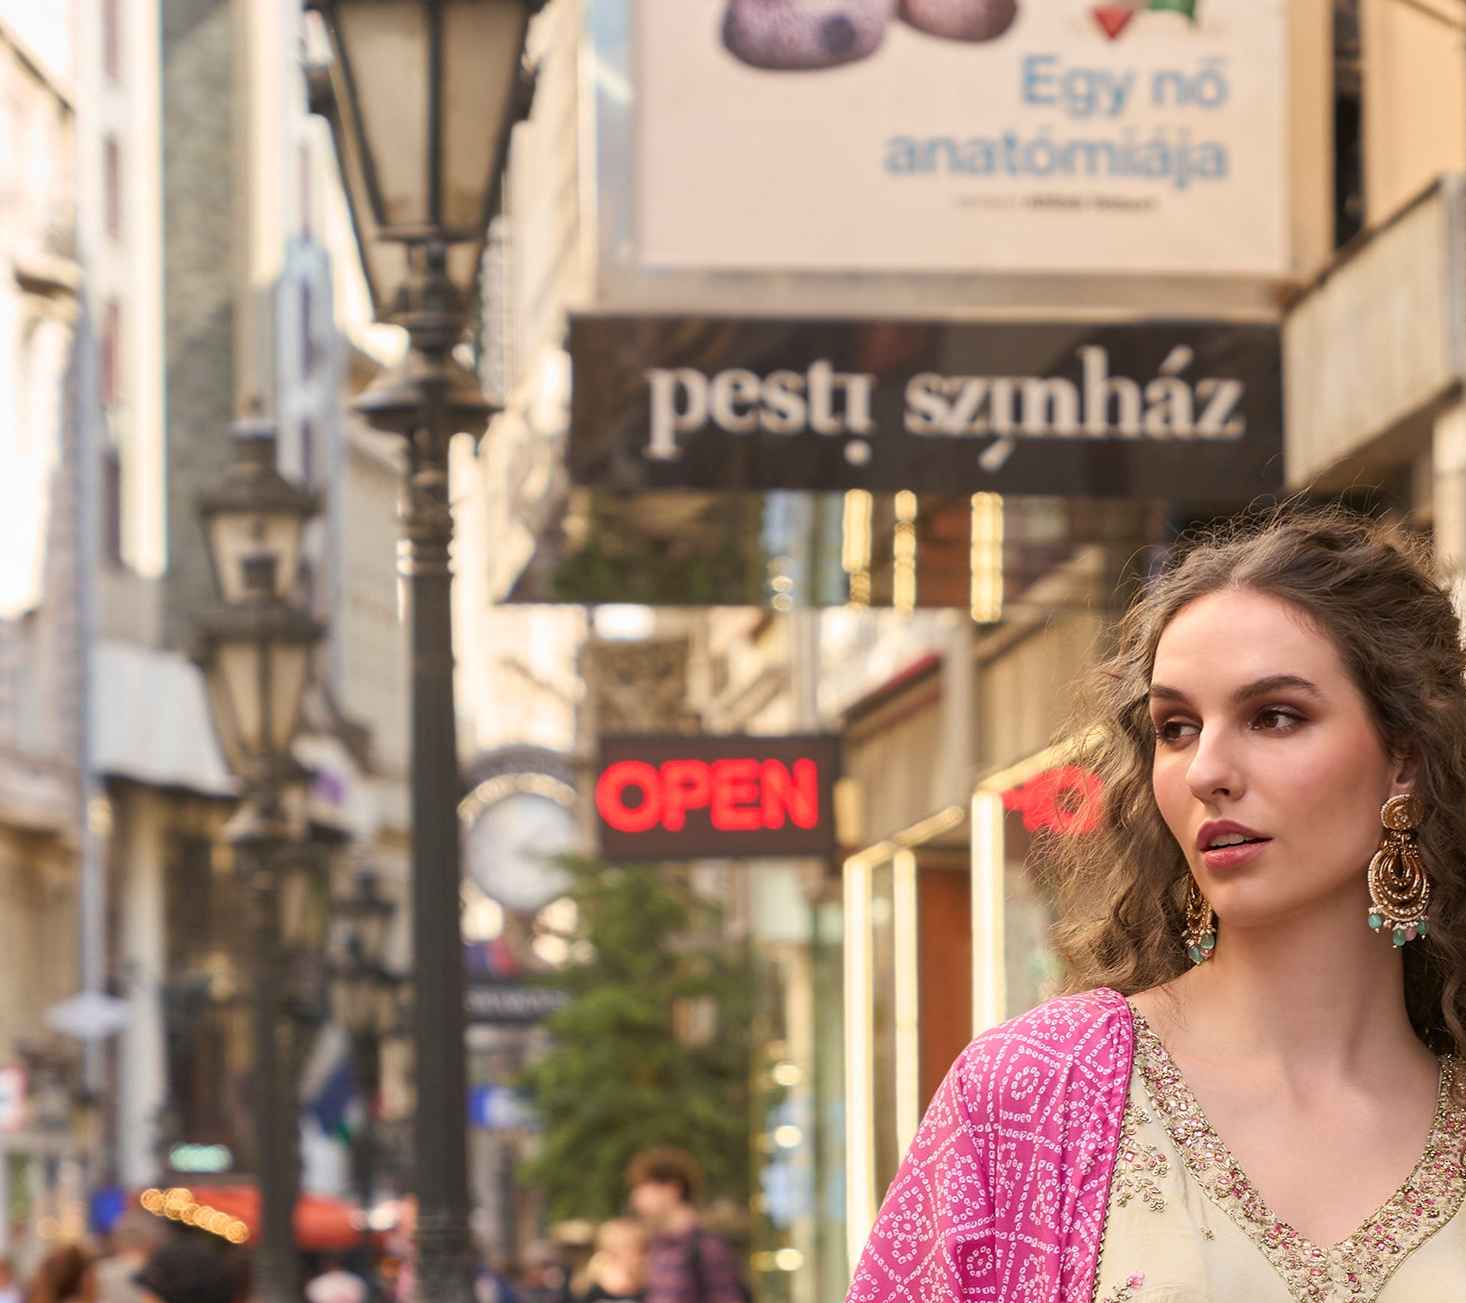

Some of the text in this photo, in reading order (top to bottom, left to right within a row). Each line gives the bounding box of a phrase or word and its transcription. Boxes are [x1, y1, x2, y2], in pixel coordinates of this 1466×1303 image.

[1022, 53, 1136, 120] Egy
[883, 127, 1230, 191] anatómiája
[643, 358, 876, 467] pesti
[596, 758, 818, 832] OPEN
